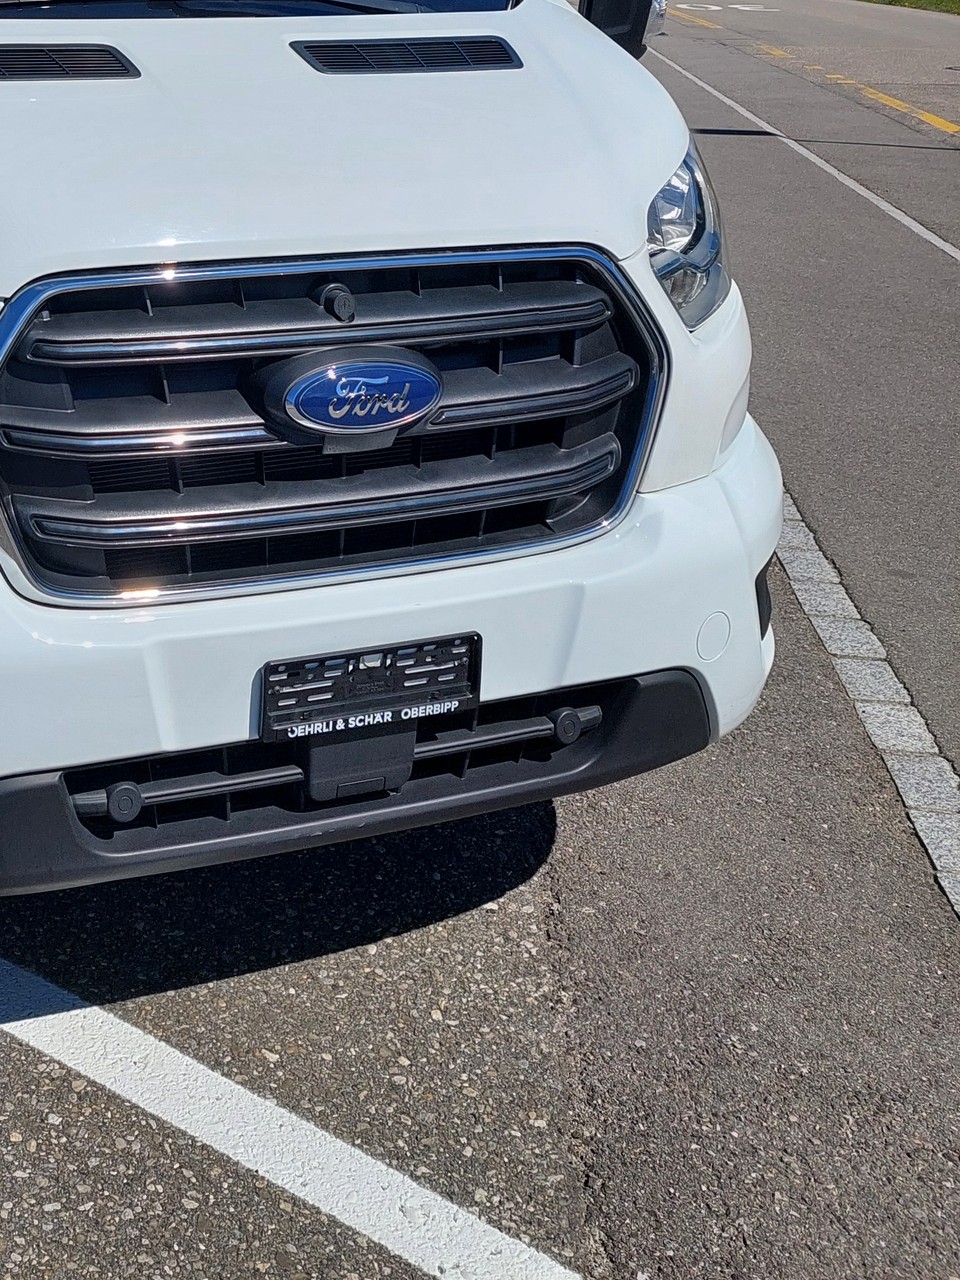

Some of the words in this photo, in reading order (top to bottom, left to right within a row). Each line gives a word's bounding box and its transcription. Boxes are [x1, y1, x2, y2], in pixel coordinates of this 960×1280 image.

[328, 376, 411, 419] Ford
[335, 719, 345, 730] &
[401, 700, 459, 720] OBERBIPP
